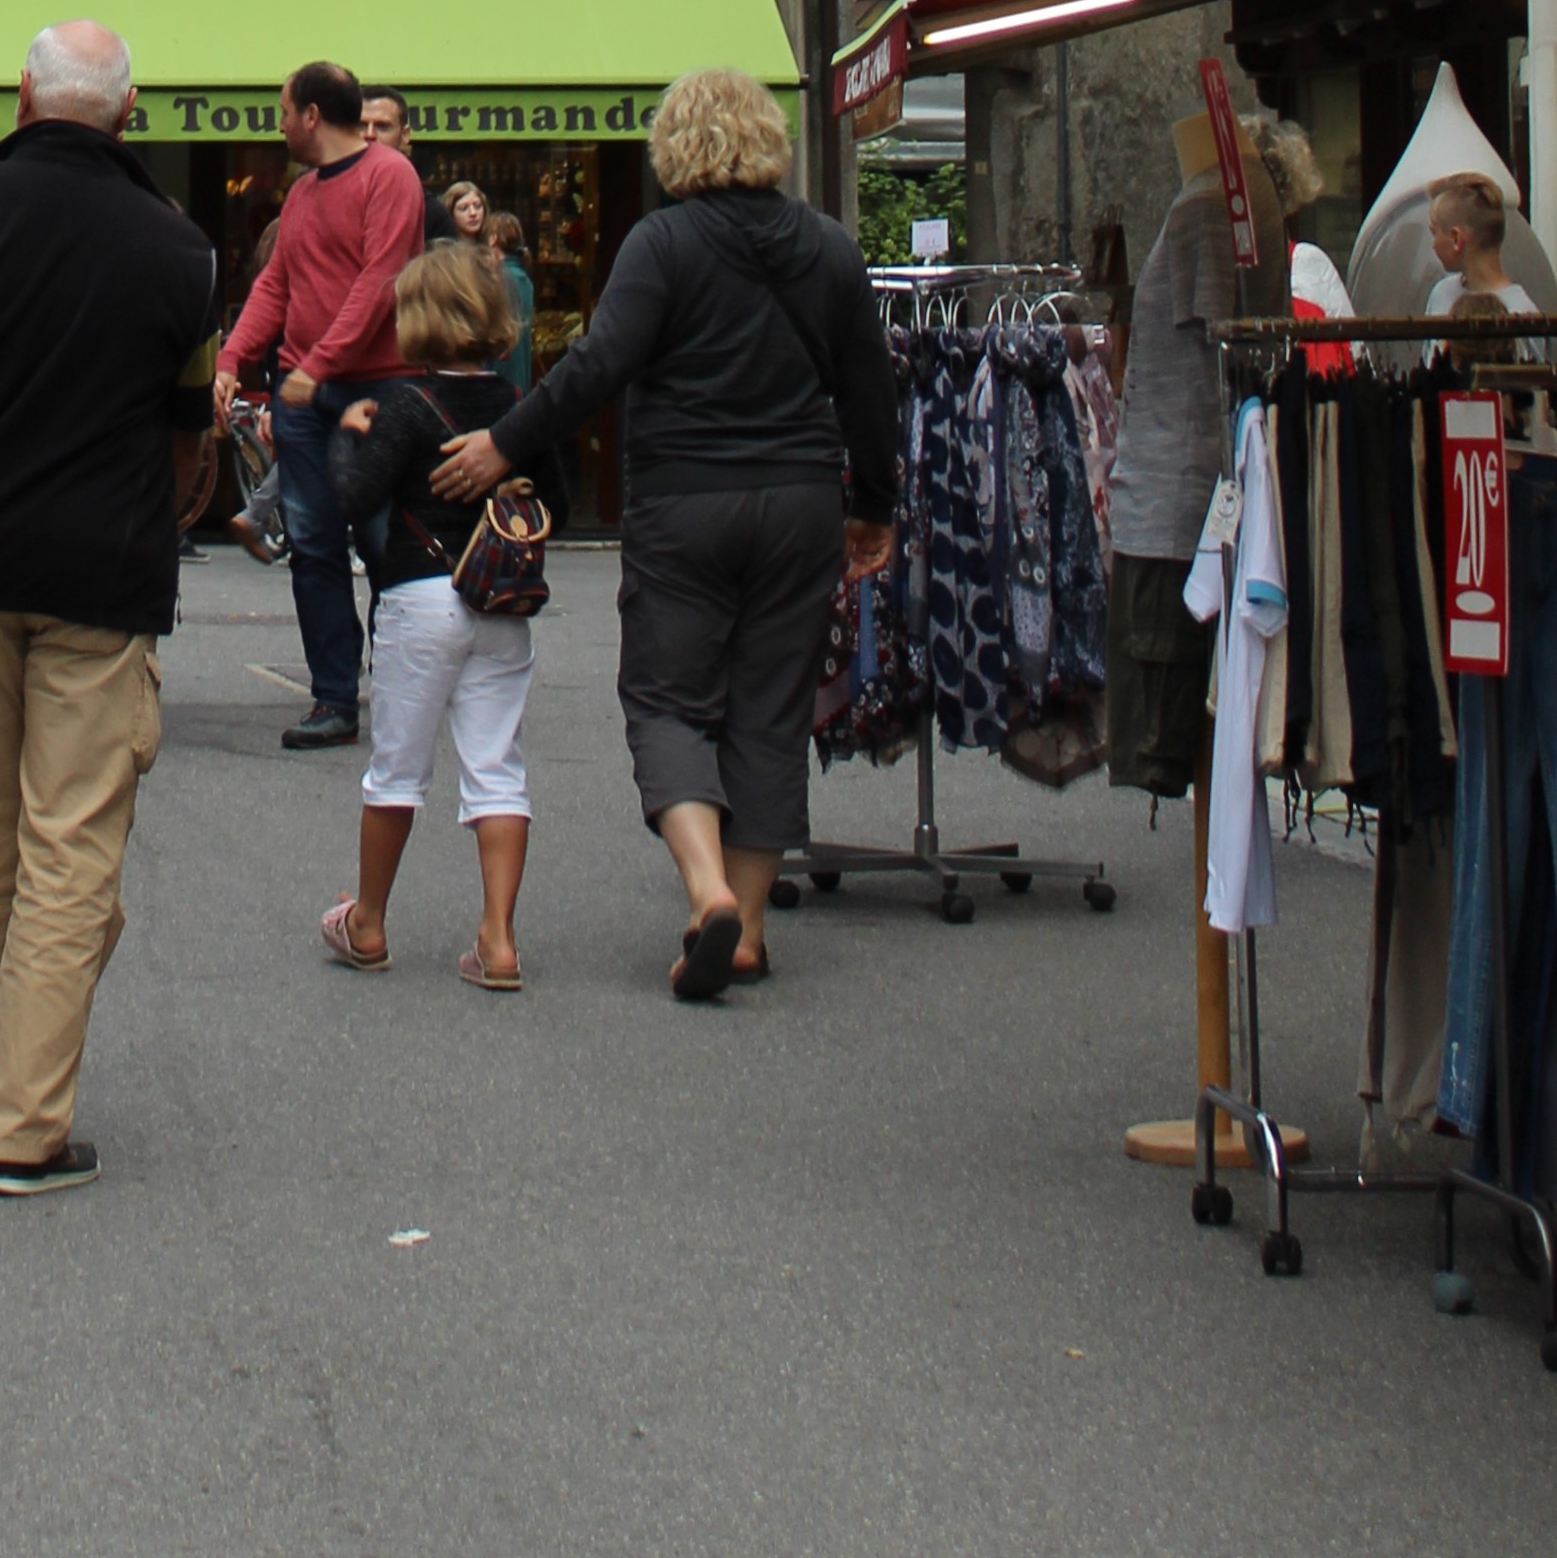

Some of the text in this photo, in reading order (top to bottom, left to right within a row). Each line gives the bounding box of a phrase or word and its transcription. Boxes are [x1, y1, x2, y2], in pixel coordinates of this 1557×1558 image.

[124, 95, 657, 132] a Tou urmande
